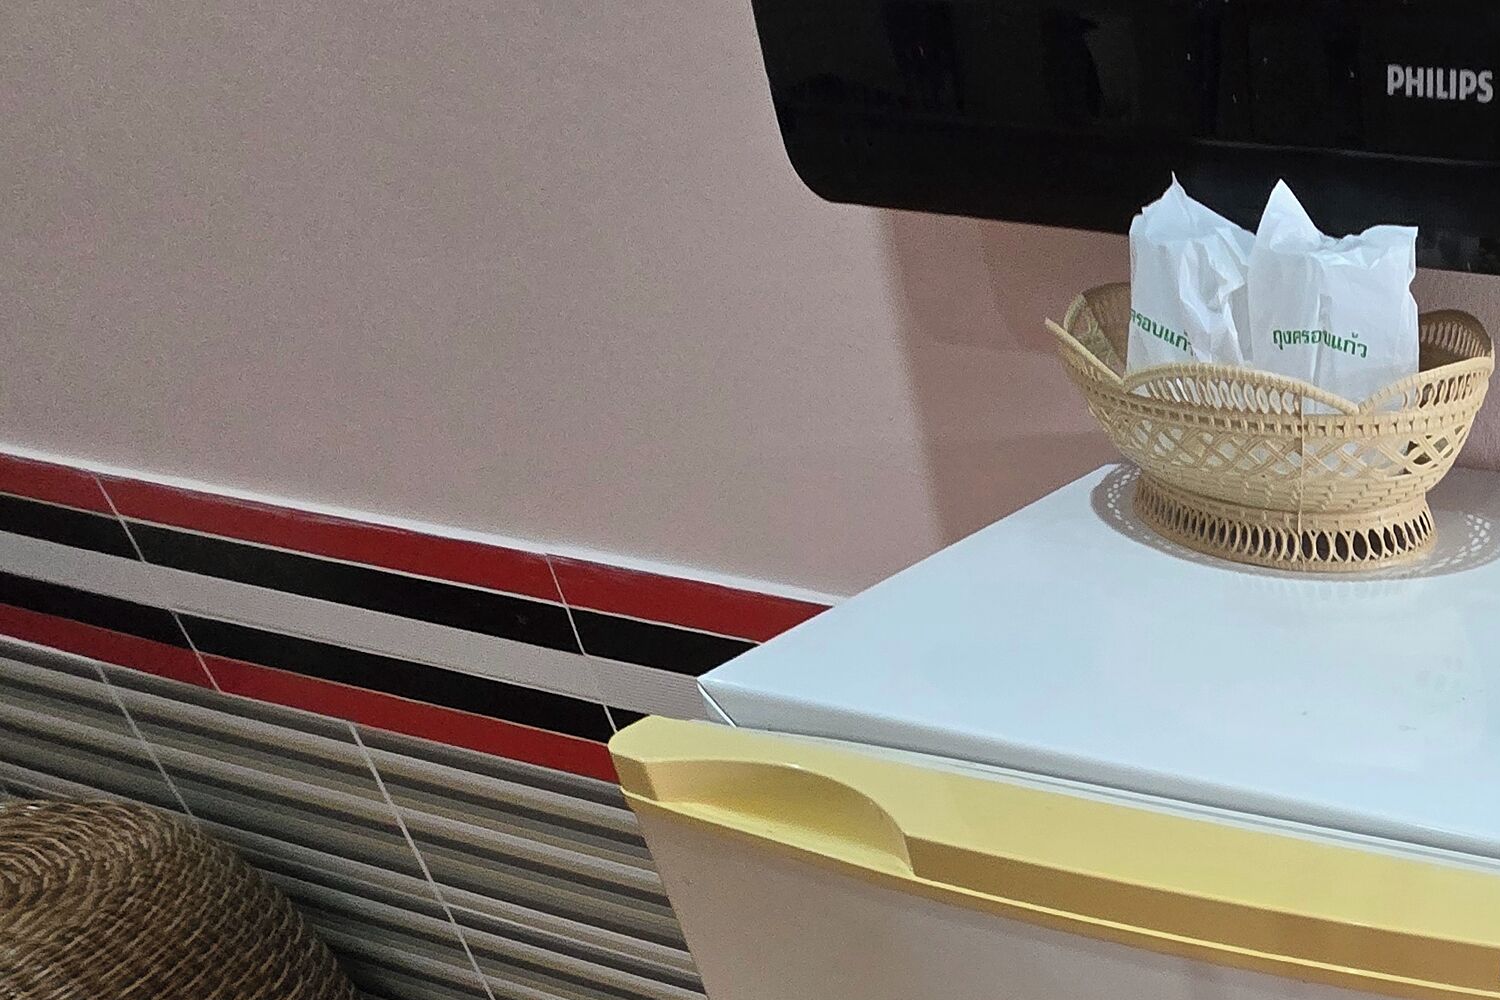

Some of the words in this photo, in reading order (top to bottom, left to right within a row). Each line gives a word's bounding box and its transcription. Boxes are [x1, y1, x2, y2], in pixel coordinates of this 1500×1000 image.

[1387, 64, 1493, 103] PHILIPS
[1273, 329, 1368, 358] ถุงครอบแก้ว
